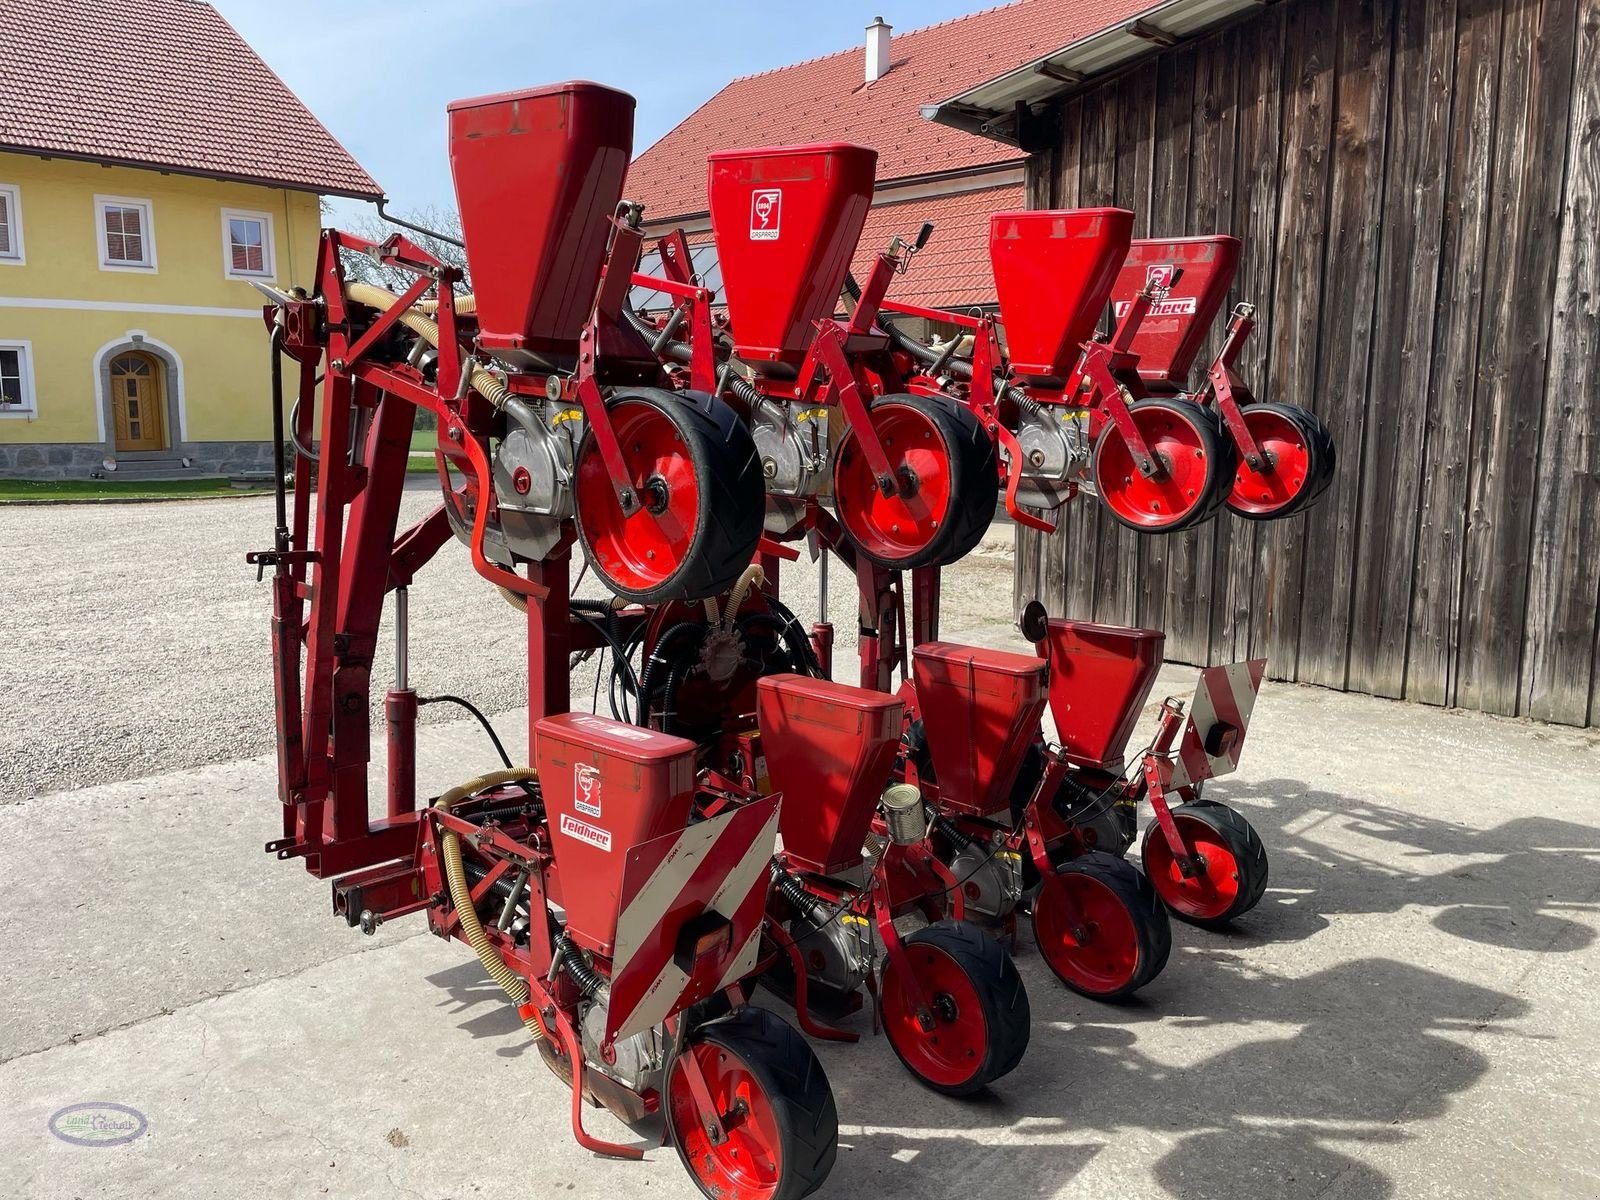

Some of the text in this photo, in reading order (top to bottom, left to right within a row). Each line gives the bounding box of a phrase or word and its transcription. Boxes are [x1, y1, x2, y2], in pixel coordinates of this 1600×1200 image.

[751, 231, 778, 239] GASPARDO
[576, 802, 600, 816] GASPARDO
[562, 816, 609, 846] Feldherr
